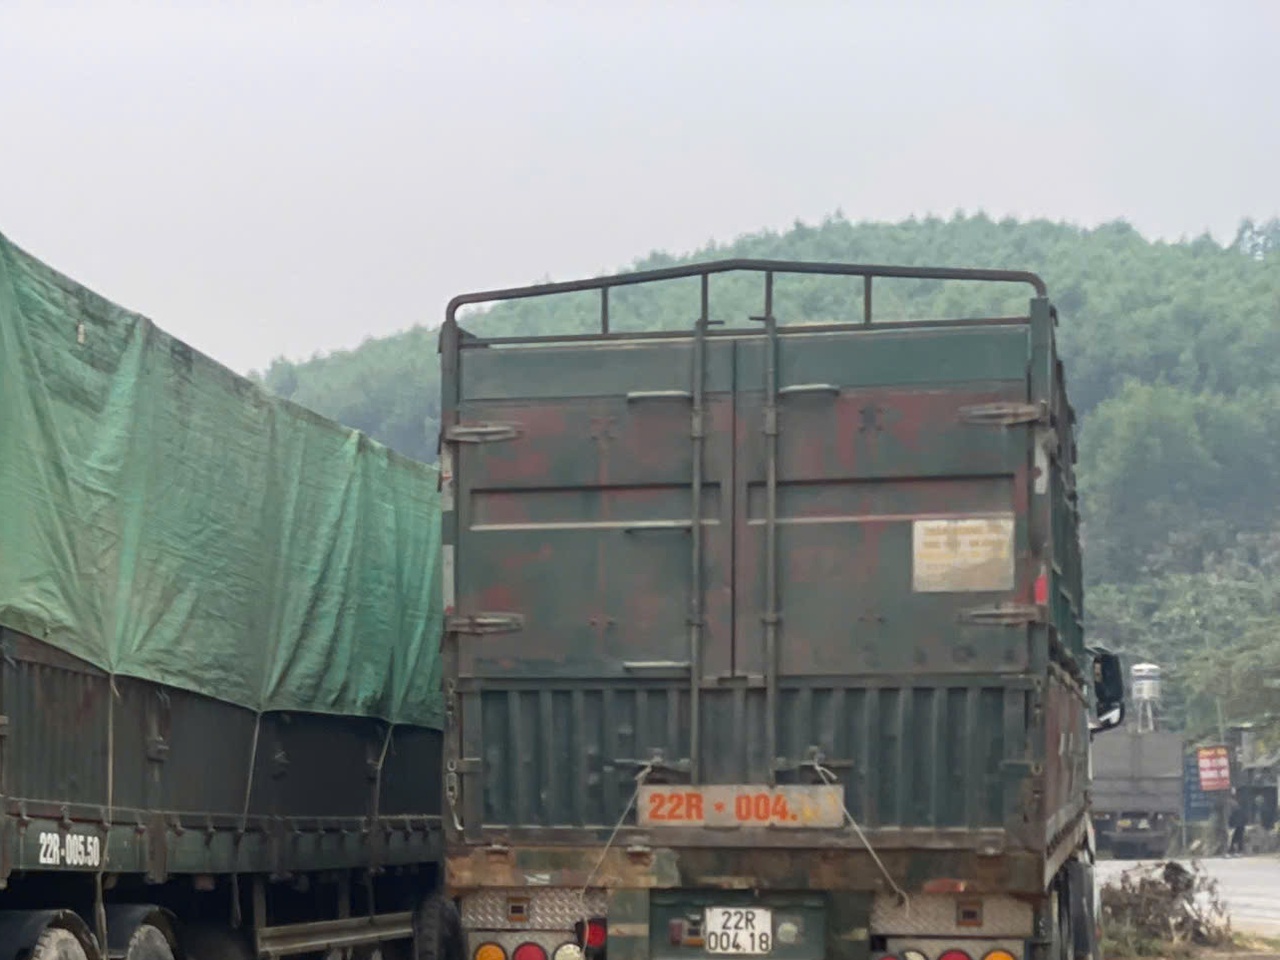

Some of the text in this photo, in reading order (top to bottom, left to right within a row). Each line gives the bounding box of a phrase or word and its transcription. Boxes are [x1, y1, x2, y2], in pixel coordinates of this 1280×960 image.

[648, 792, 704, 821] 22R
[722, 910, 756, 930] 22R
[708, 931, 769, 952] 004.18
